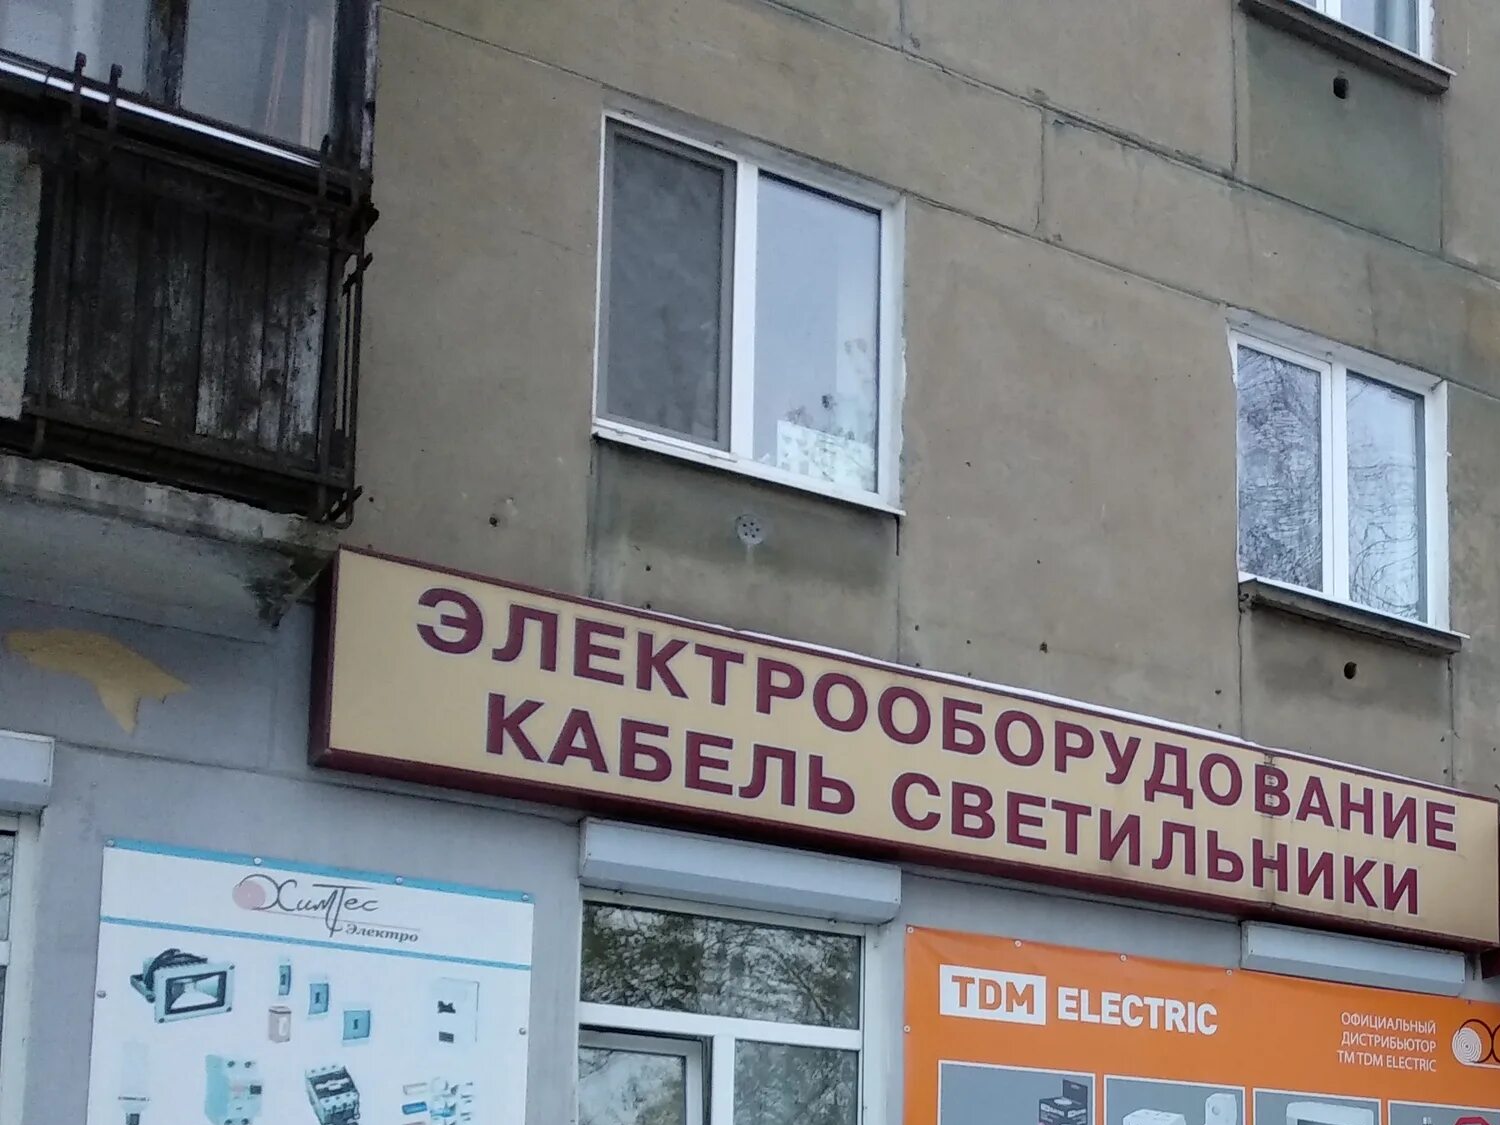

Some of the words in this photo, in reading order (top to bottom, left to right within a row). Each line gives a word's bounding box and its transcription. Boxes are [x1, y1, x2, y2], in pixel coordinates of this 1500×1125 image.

[416, 587, 1458, 852] ЭЛЕКТРООБОРУДОВАНИЕ
[485, 692, 857, 816] КАБЕЛЬ
[891, 772, 1419, 916] СВЕТИЛЬНИКИ
[345, 923, 419, 944] Электро
[951, 975, 1035, 1015] TDM
[1057, 986, 1218, 1036] ELECTRIC
[1340, 1011, 1437, 1035] ОФИЦИАЛЬНЫЙ
[1340, 1032, 1437, 1053] ДИСТРИБЬЮТОР
[1356, 1051, 1384, 1067] TDM
[1386, 1053, 1437, 1073] ELECTRIC
